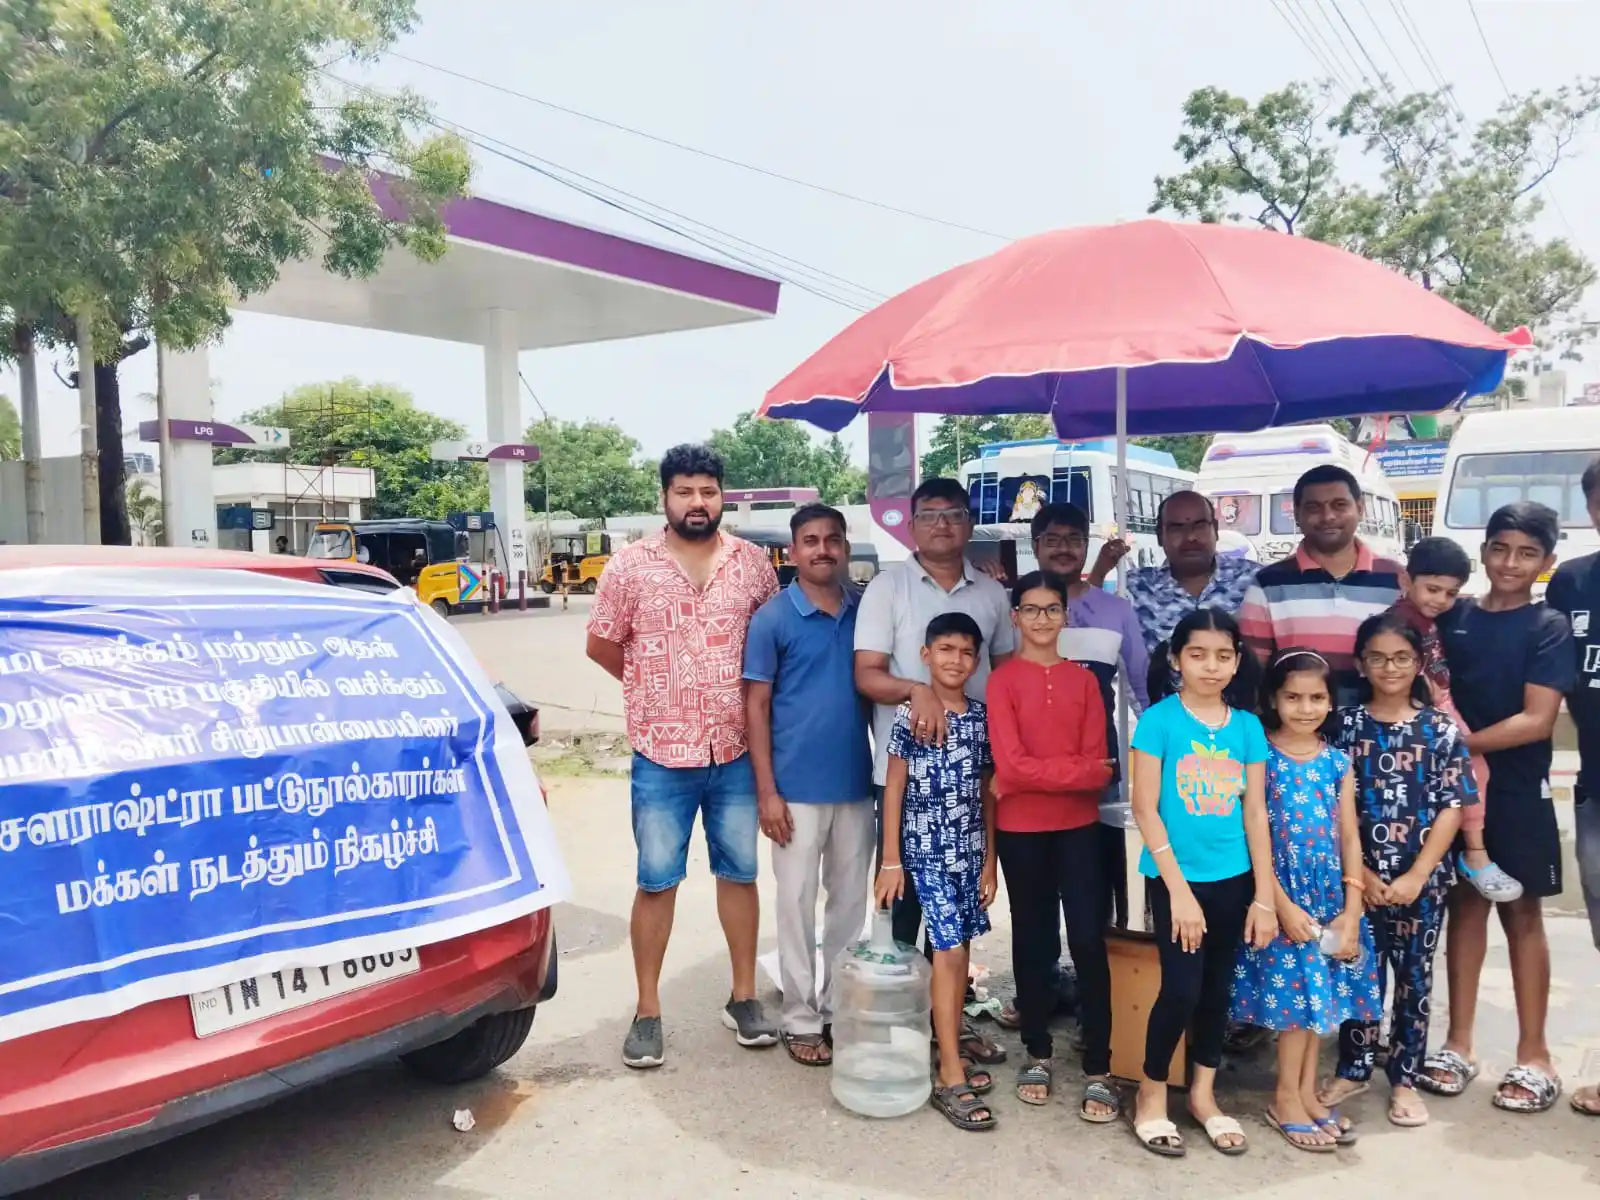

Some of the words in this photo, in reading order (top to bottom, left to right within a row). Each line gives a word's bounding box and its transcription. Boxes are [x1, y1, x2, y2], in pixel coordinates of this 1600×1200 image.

[194, 425, 214, 436] LPG
[476, 444, 483, 455] 2
[512, 448, 525, 456] LPG
[202, 630, 317, 667] மற்றும்
[323, 633, 398, 661] அதன்
[335, 669, 447, 698] வசிக்கும்
[55, 849, 181, 914] மக்கள்
[189, 827, 329, 901] நடத்தும்
[334, 816, 439, 878] நிகழ்ச்சி
